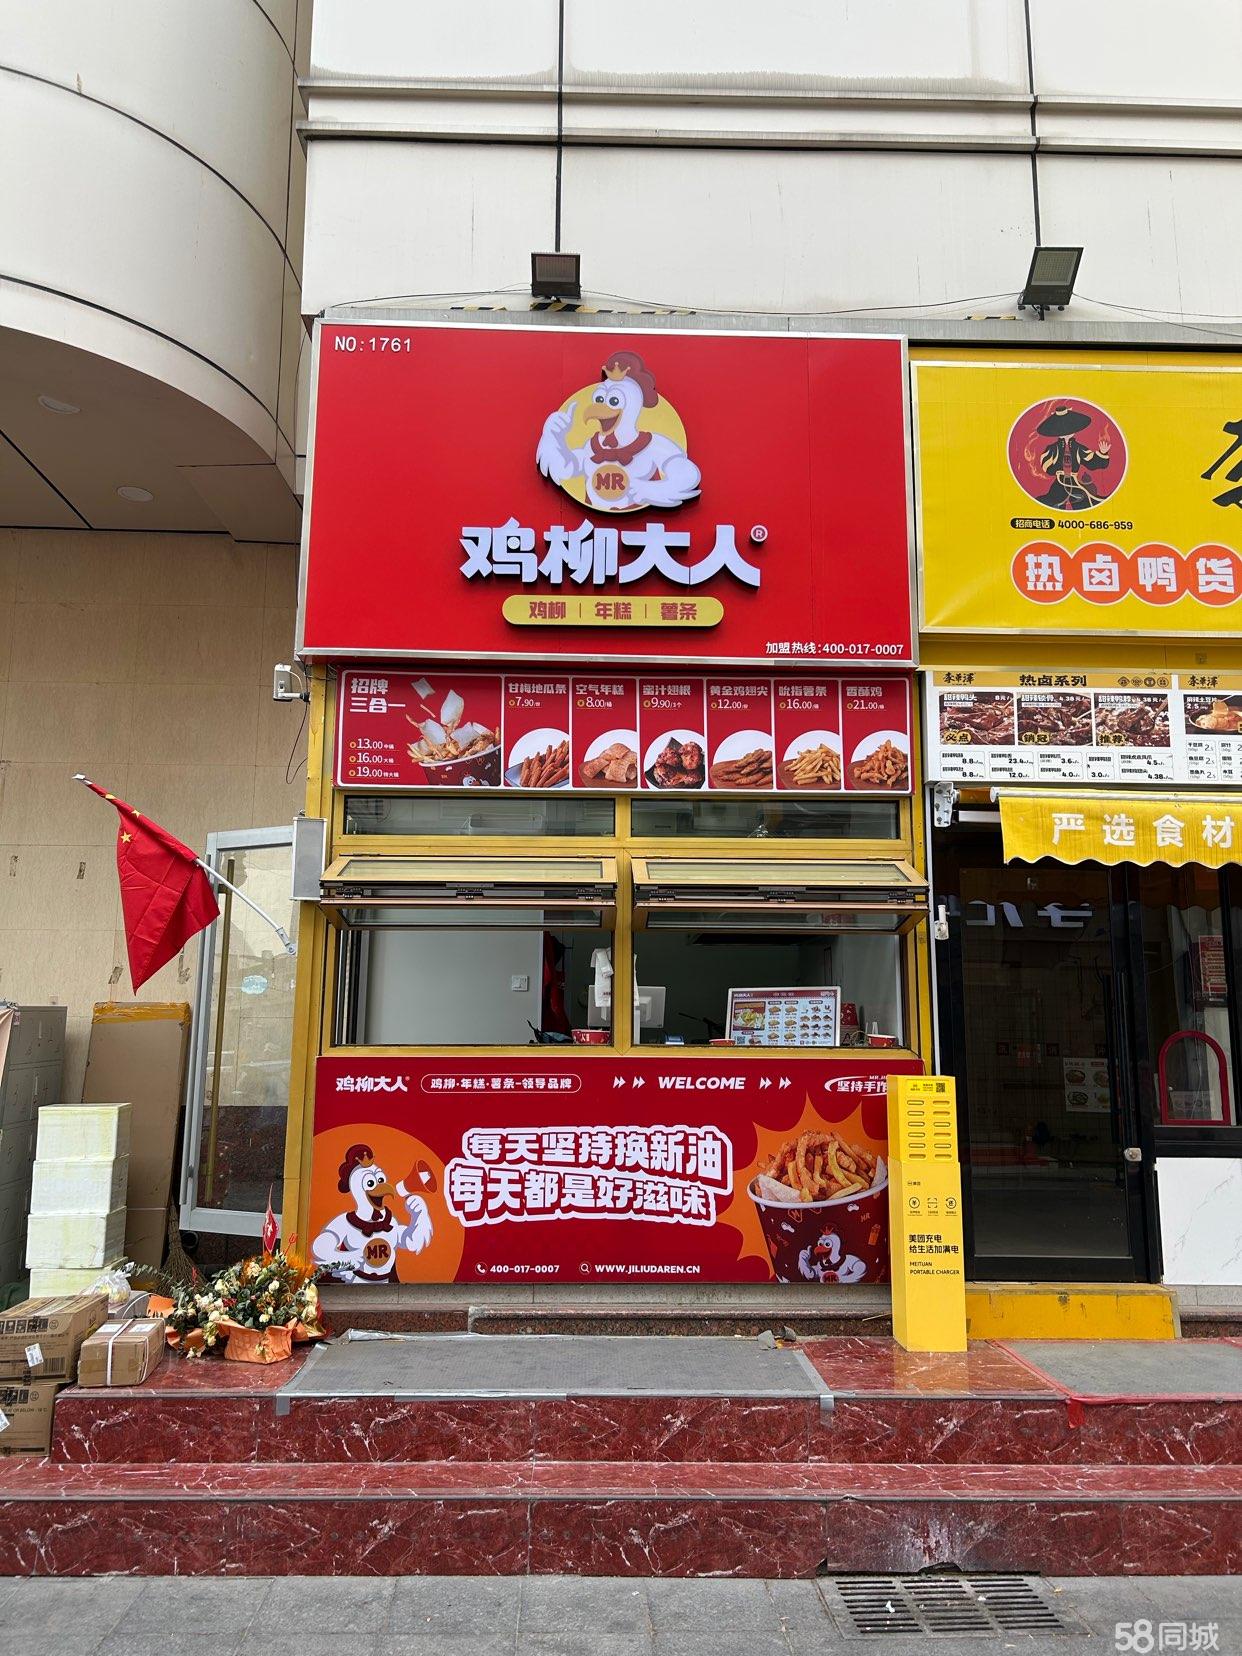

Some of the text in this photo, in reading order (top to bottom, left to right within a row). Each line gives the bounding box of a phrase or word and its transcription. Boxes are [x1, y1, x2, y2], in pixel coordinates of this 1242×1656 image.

[595, 470, 626, 492] MR
[1015, 519, 1134, 531] 招商电话 4000-686-959
[459, 517, 762, 588] 鸡柳大人
[1024, 553, 1236, 594] 热卤鸭货
[528, 601, 699, 622] 鸡柳 年糕 薯条
[350, 677, 389, 696] 招牌
[1020, 674, 1088, 687] 热卤系列
[575, 684, 625, 696] 空气年糕
[709, 685, 769, 698] 黄金鸡翅尖
[349, 696, 407, 714] 三合一
[1051, 812, 1236, 849] 严选食材
[335, 1075, 409, 1093] 鸡柳大人
[658, 1076, 747, 1090] WELCOME
[469, 1131, 725, 1182] 每天坚持换新油
[449, 1165, 709, 1216] 每天都是好滋味
[908, 1234, 942, 1244] 美团充电
[366, 1244, 390, 1260] MR
[908, 1244, 960, 1254] 给生活加满电
[489, 1264, 560, 1274] 400-017-0007
[594, 1264, 701, 1274] WWW.JILIUDAREN.CN
